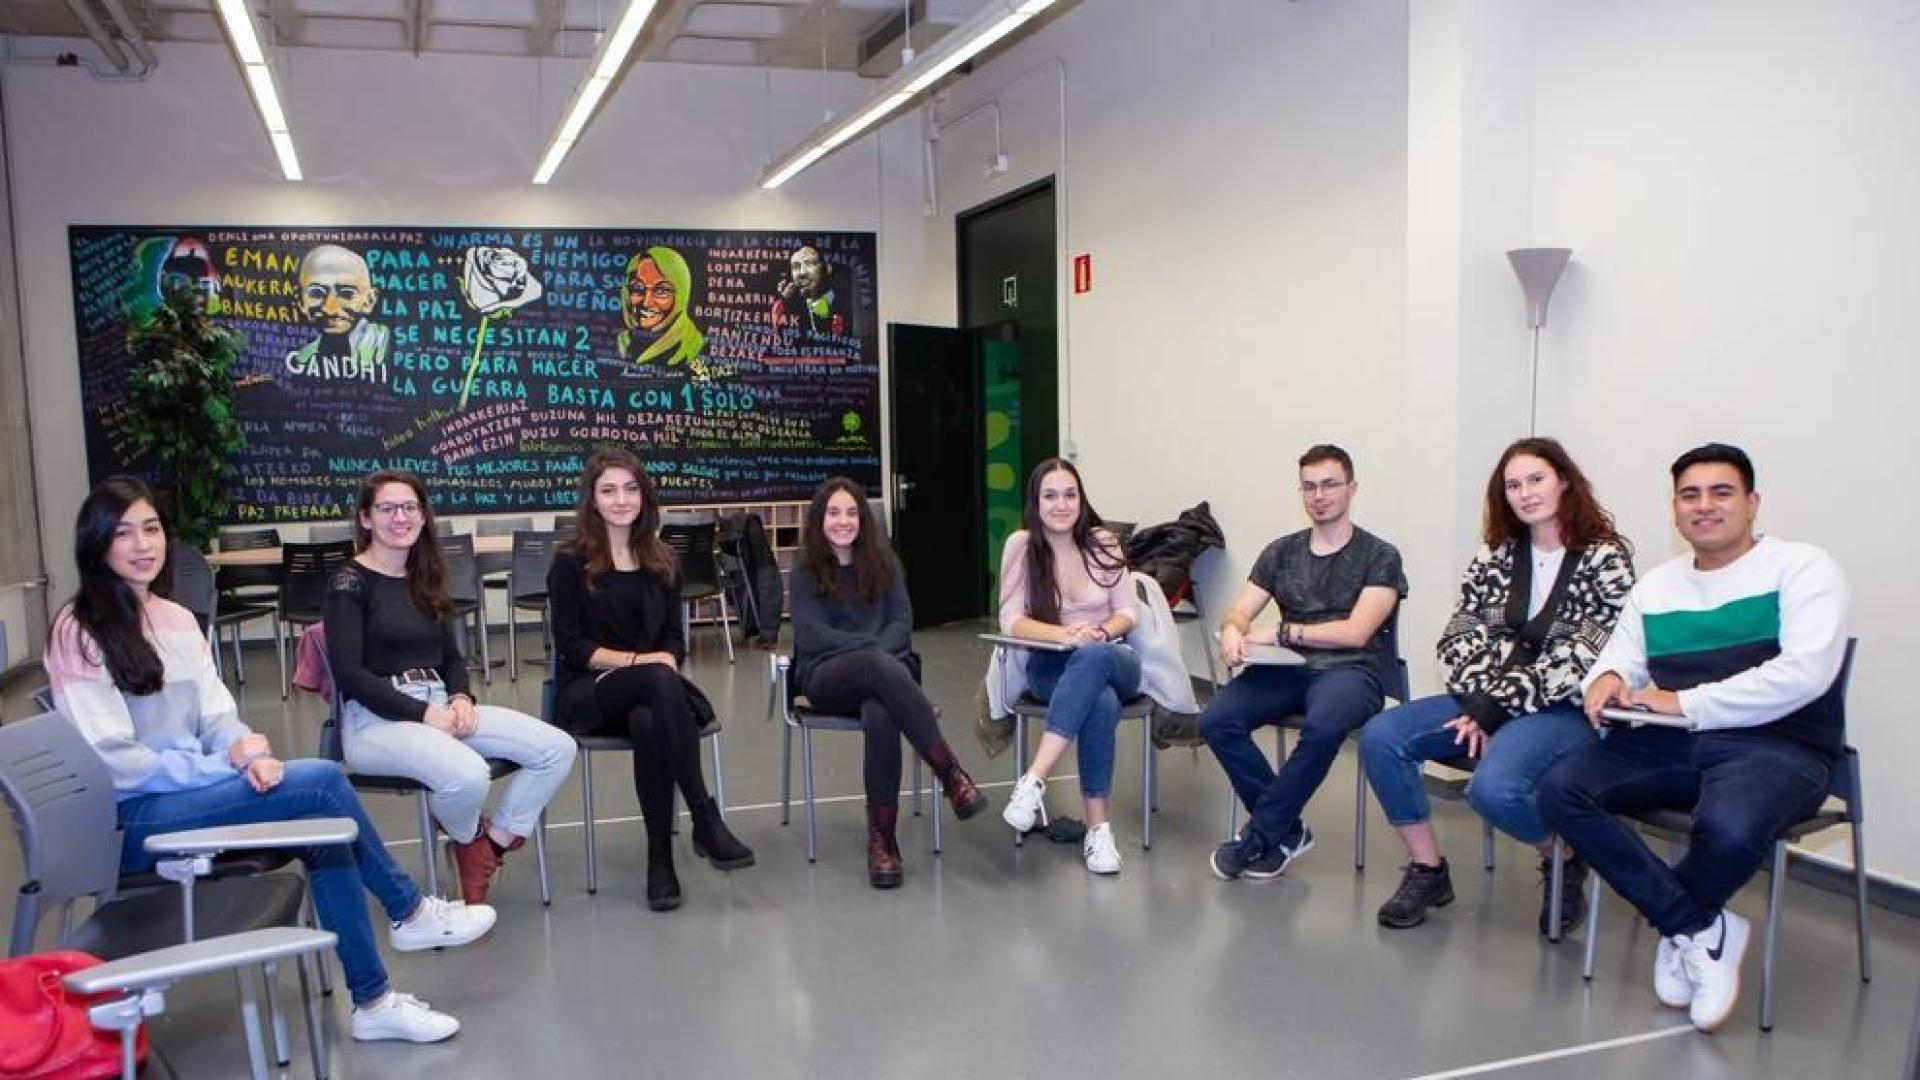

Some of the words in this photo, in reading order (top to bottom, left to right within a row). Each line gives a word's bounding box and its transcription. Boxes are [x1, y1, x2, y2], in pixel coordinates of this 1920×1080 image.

[553, 233, 579, 248] UN
[767, 236, 802, 249] CIMA
[224, 246, 299, 273] EMAN
[365, 248, 431, 270] PARA
[531, 249, 627, 269] ENEMIGO
[707, 263, 769, 275] LORTZEN
[371, 271, 447, 293] HACER
[543, 270, 596, 288] PARA
[707, 276, 746, 289] DENA
[382, 298, 407, 317] LA
[418, 299, 463, 321] PAZ
[546, 289, 622, 311] DUEÑO
[394, 325, 419, 345] SE
[432, 325, 568, 348] NECESITAN
[574, 326, 591, 351] 2
[286, 350, 387, 385] GANDHI
[393, 351, 450, 373] PERO
[461, 355, 519, 375] PARA
[531, 359, 600, 380] HACER
[393, 376, 418, 396] LA
[431, 376, 528, 399] GUERRA
[547, 383, 616, 411] BASTA
[628, 388, 673, 412] CON
[680, 383, 696, 414] 1
[702, 387, 755, 412] SOLO
[595, 411, 618, 425] HIL
[653, 428, 680, 444] HIL
[328, 454, 382, 474] NUNCA
[388, 456, 440, 475] LLEVES
[450, 491, 468, 504] LA
[519, 492, 537, 504] LA
[544, 489, 583, 506] LIBER
[237, 503, 265, 521] PAZ
